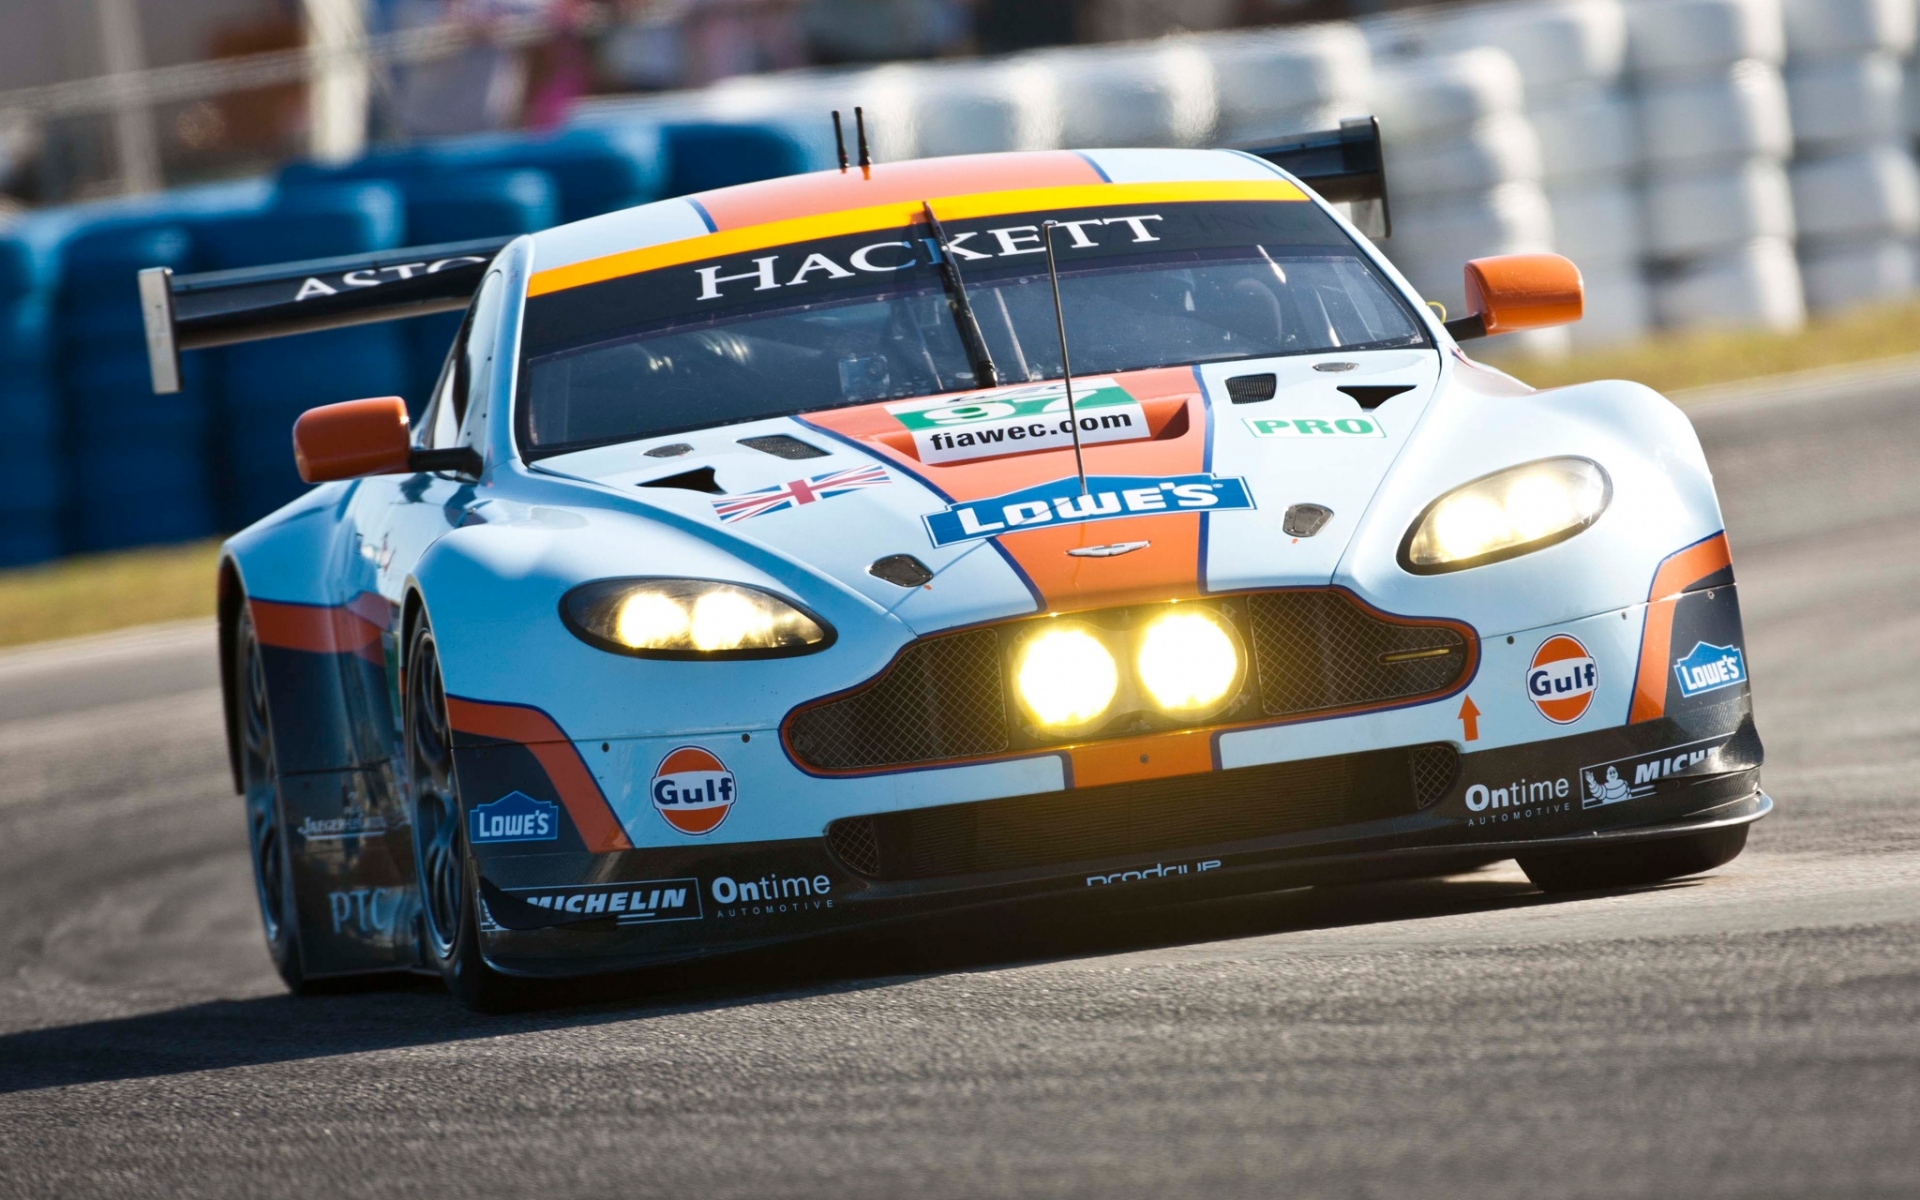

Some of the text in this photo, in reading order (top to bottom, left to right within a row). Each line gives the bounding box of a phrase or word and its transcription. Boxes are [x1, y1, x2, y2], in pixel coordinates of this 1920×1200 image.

[696, 214, 1164, 300] HACKETT
[923, 389, 1098, 425] 97
[930, 413, 1132, 450] fiawec.com
[1254, 418, 1374, 435] PRO
[956, 481, 1220, 535] LOWE'S
[1529, 663, 1595, 696] Gulf
[1680, 655, 1740, 690] LOWE'S
[654, 777, 733, 805] Gulf
[1465, 777, 1570, 812] Ontime
[478, 810, 550, 838] LOWE'S
[1468, 802, 1571, 827] AUTOMOTIVE
[711, 874, 832, 904] Ontime
[328, 887, 388, 934] PTC
[717, 900, 834, 919] AUTOMOTIVE
